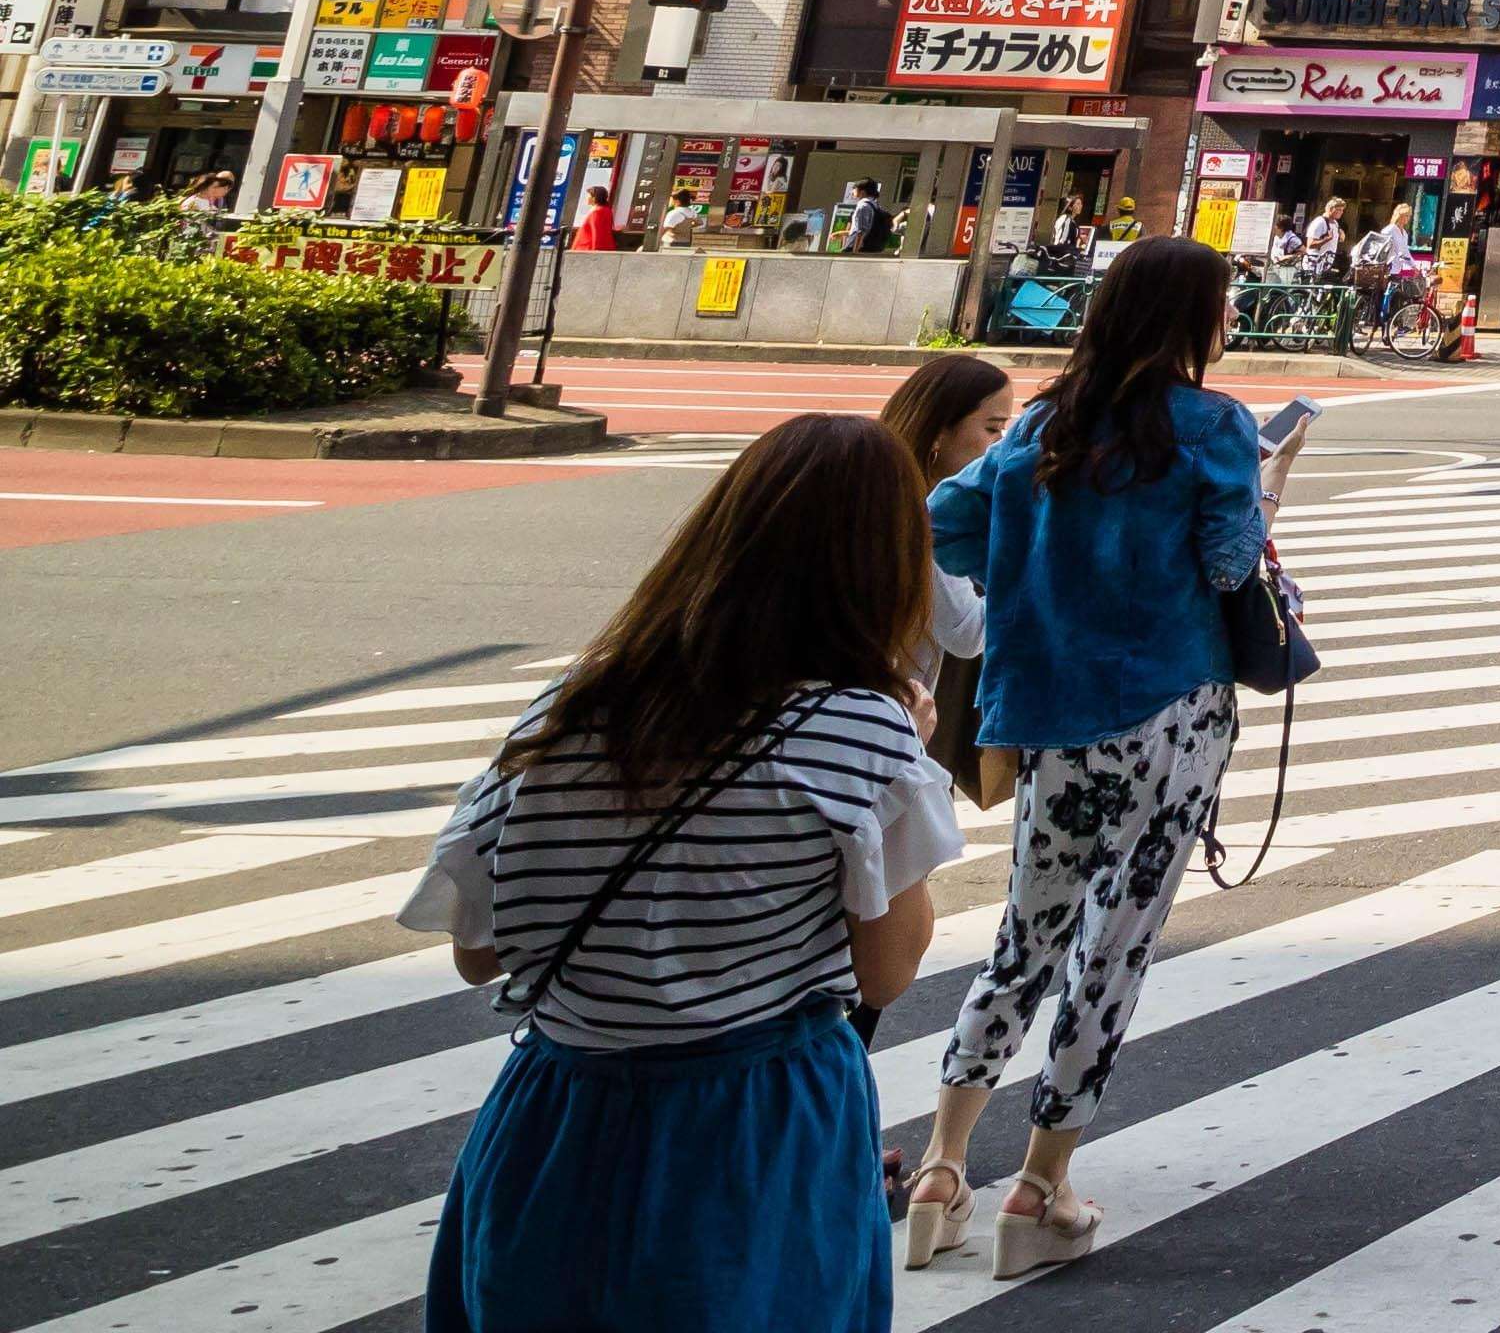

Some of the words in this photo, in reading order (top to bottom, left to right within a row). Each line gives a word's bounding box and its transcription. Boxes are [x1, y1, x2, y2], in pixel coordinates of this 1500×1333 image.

[899, 27, 928, 70] 東京
[926, 28, 1109, 74] チカラめし
[1300, 61, 1367, 101] Roko
[1372, 64, 1443, 104] Shira
